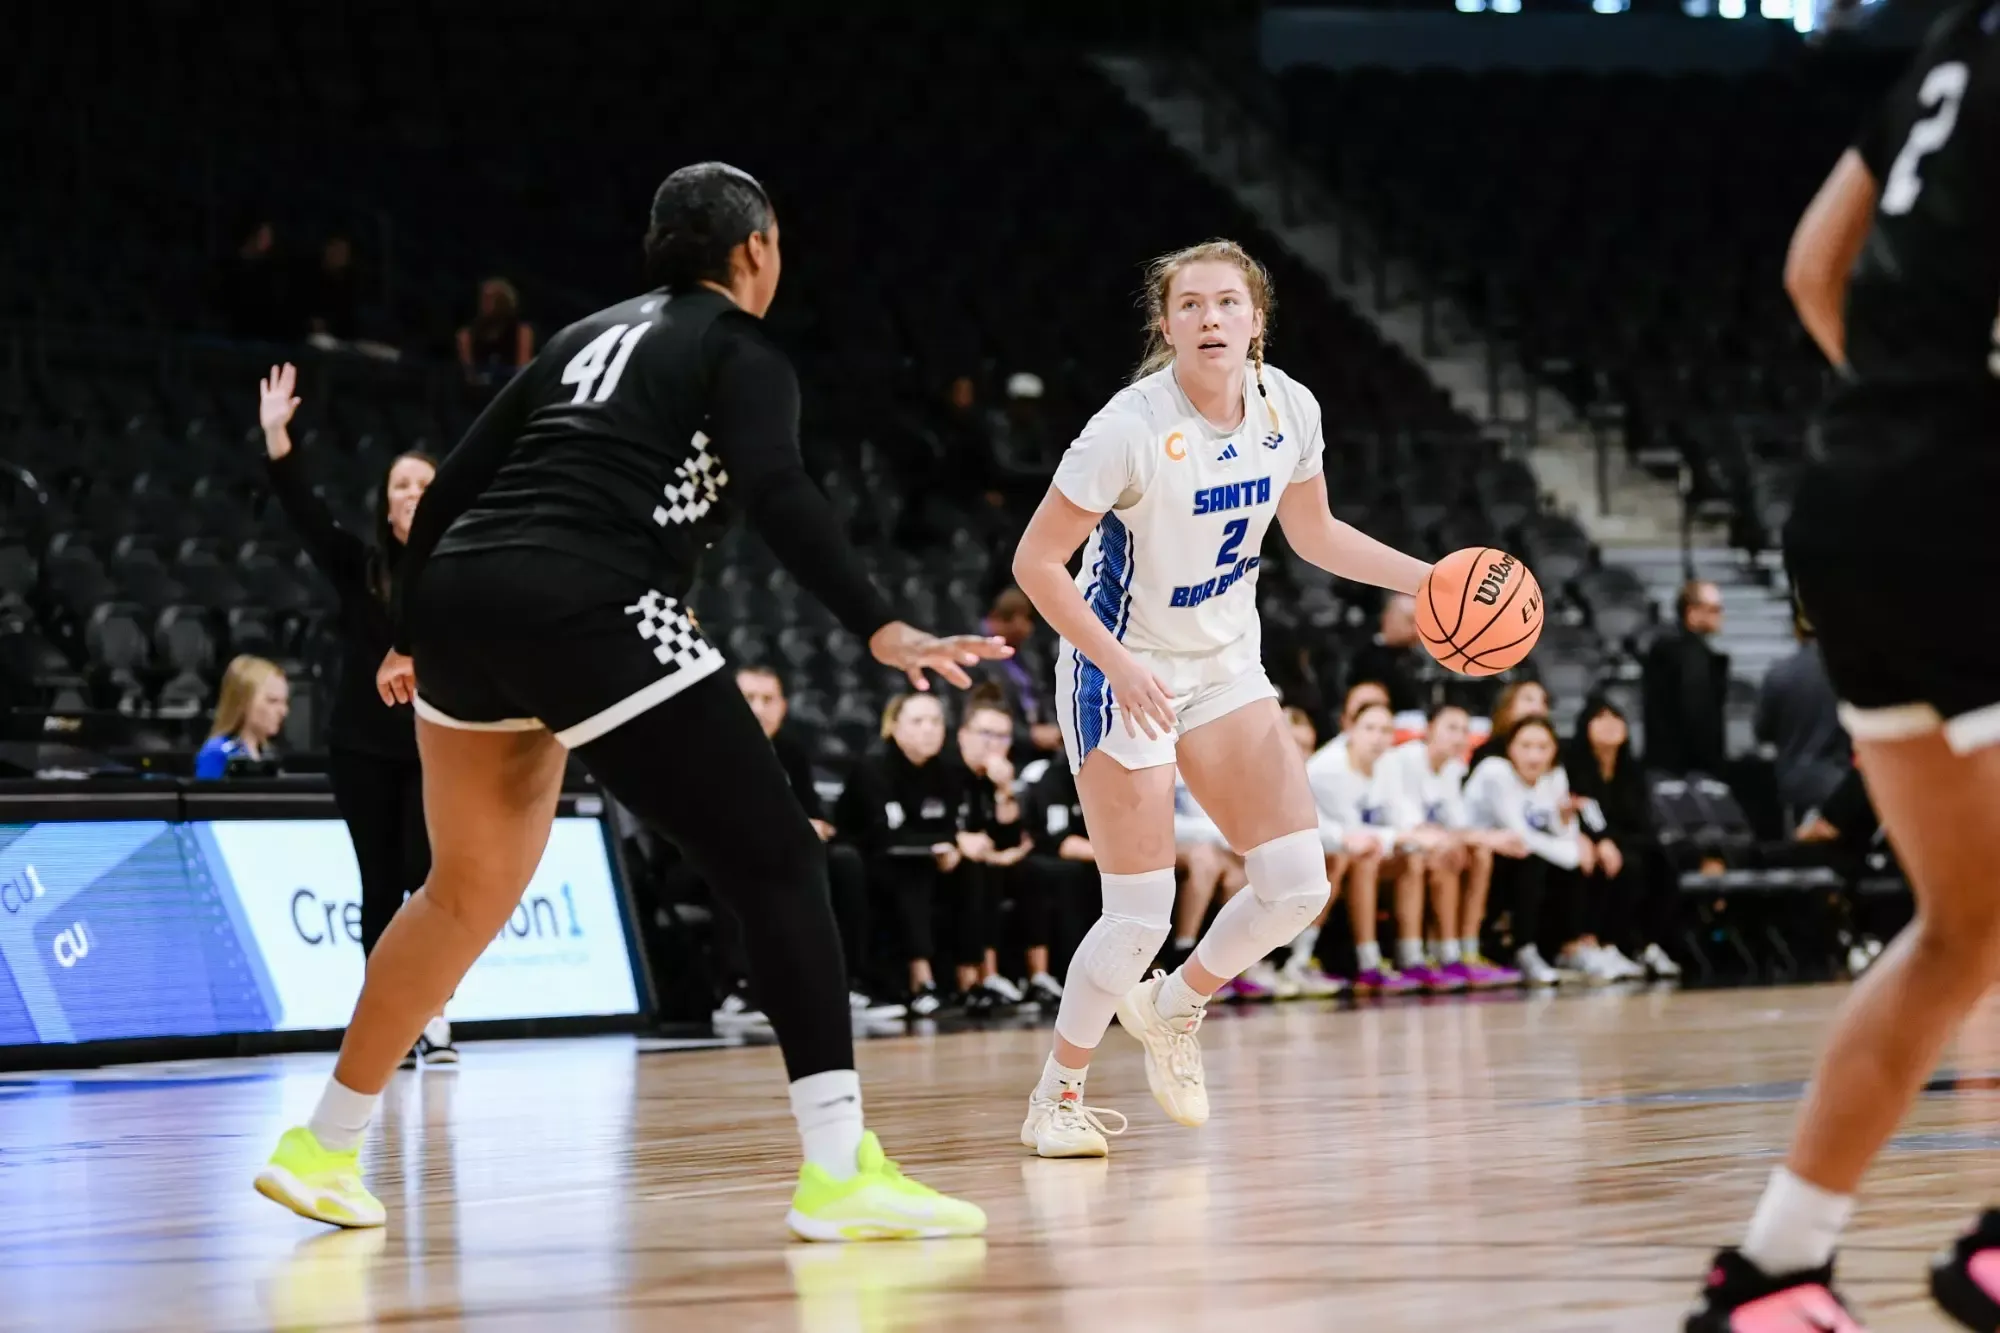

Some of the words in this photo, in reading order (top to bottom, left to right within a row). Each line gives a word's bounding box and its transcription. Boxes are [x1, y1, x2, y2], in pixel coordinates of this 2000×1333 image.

[1881, 61, 1970, 216] 2
[561, 321, 653, 405] 41
[1192, 476, 1271, 516] SANTA
[1215, 517, 1250, 569] 2
